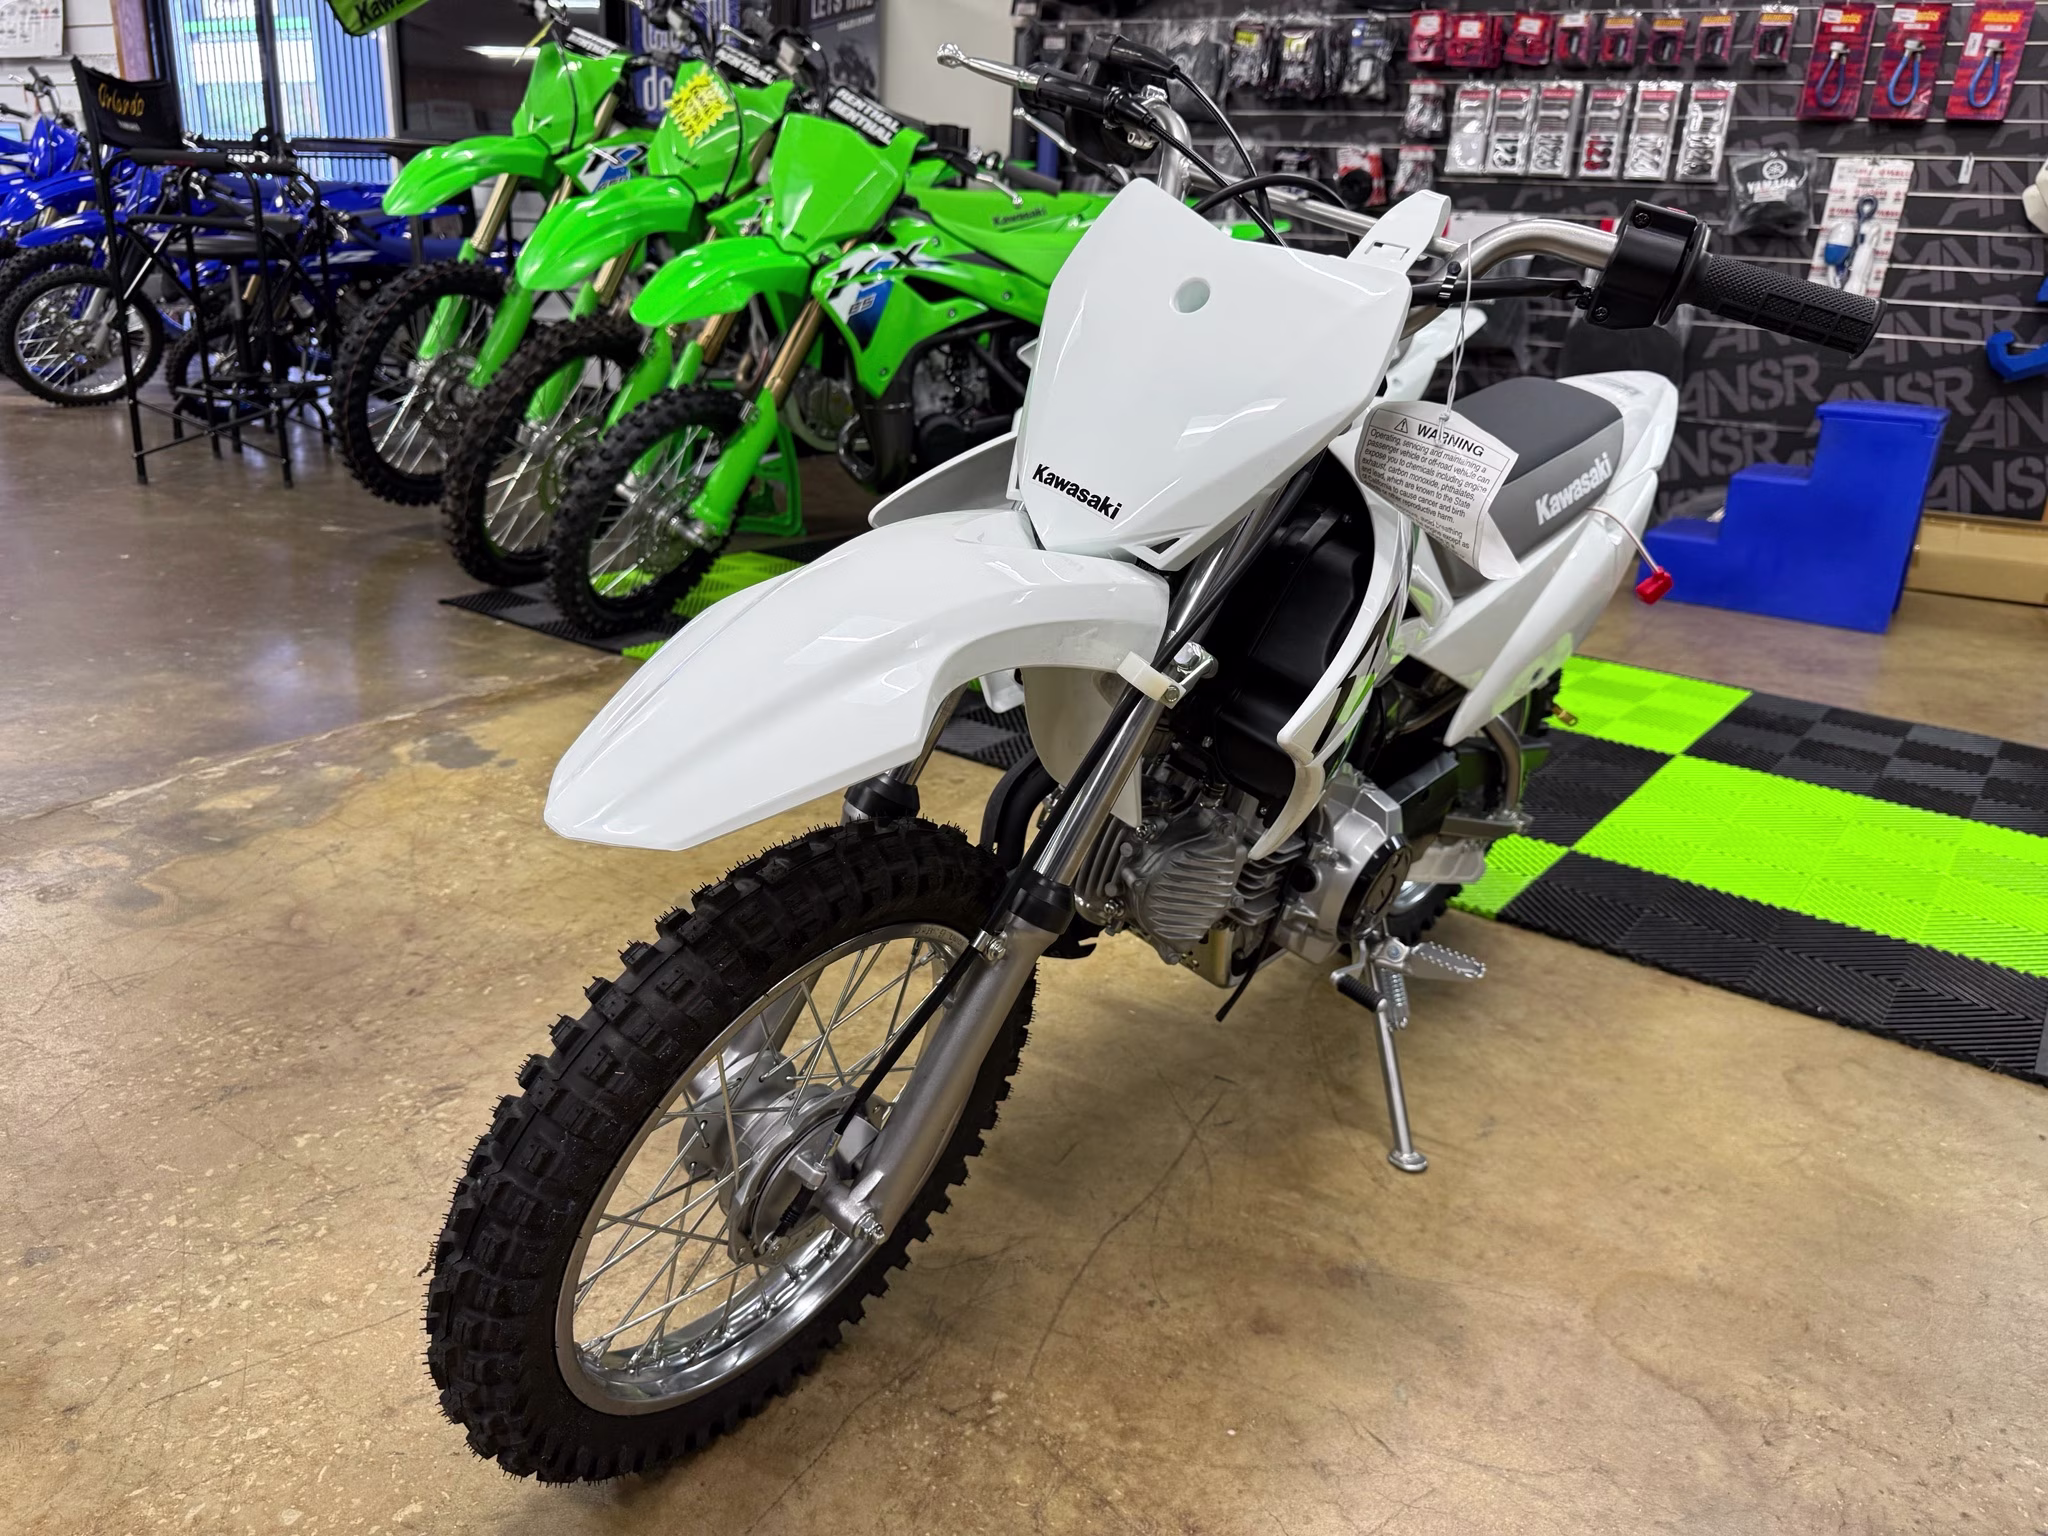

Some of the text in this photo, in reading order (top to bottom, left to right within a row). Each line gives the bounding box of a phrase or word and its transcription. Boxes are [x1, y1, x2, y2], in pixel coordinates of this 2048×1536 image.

[828, 98, 893, 145] RENTHAL
[836, 87, 900, 133] RENTHAL
[1677, 354, 1824, 421] ANSR
[1366, 439, 1400, 455] passenger
[1400, 449, 1420, 461] vehicle
[1428, 459, 1454, 472] off-road
[1453, 466, 1477, 480] vehicle
[1476, 475, 1491, 485] can
[1402, 440, 1430, 456] servicing
[1429, 448, 1444, 458] and
[1442, 453, 1482, 472] maintaining
[1417, 423, 1485, 458] WARNING
[1032, 463, 1123, 520] Kawasaki
[1364, 448, 1488, 493] expose you to chemicals including engine
[1386, 475, 1404, 487] which
[1404, 481, 1415, 490] are
[1415, 484, 1435, 497] known
[1435, 491, 1443, 500] to
[1442, 493, 1454, 504] the
[1453, 496, 1472, 510] State
[1387, 466, 1409, 478] carbon
[1440, 484, 1476, 502] phthalates,
[1535, 451, 1612, 526] Kawasaki
[1924, 454, 2048, 515] ANS
[1392, 486, 1400, 494] to
[1399, 489, 1418, 501] cause
[1417, 496, 1439, 508] cancer
[1438, 503, 1452, 513] and
[1451, 506, 1466, 518] birth
[1401, 498, 1437, 517] reproductive
[1436, 511, 1455, 523] harm.
[1442, 532, 1461, 547] except
[1461, 541, 1470, 550] as
